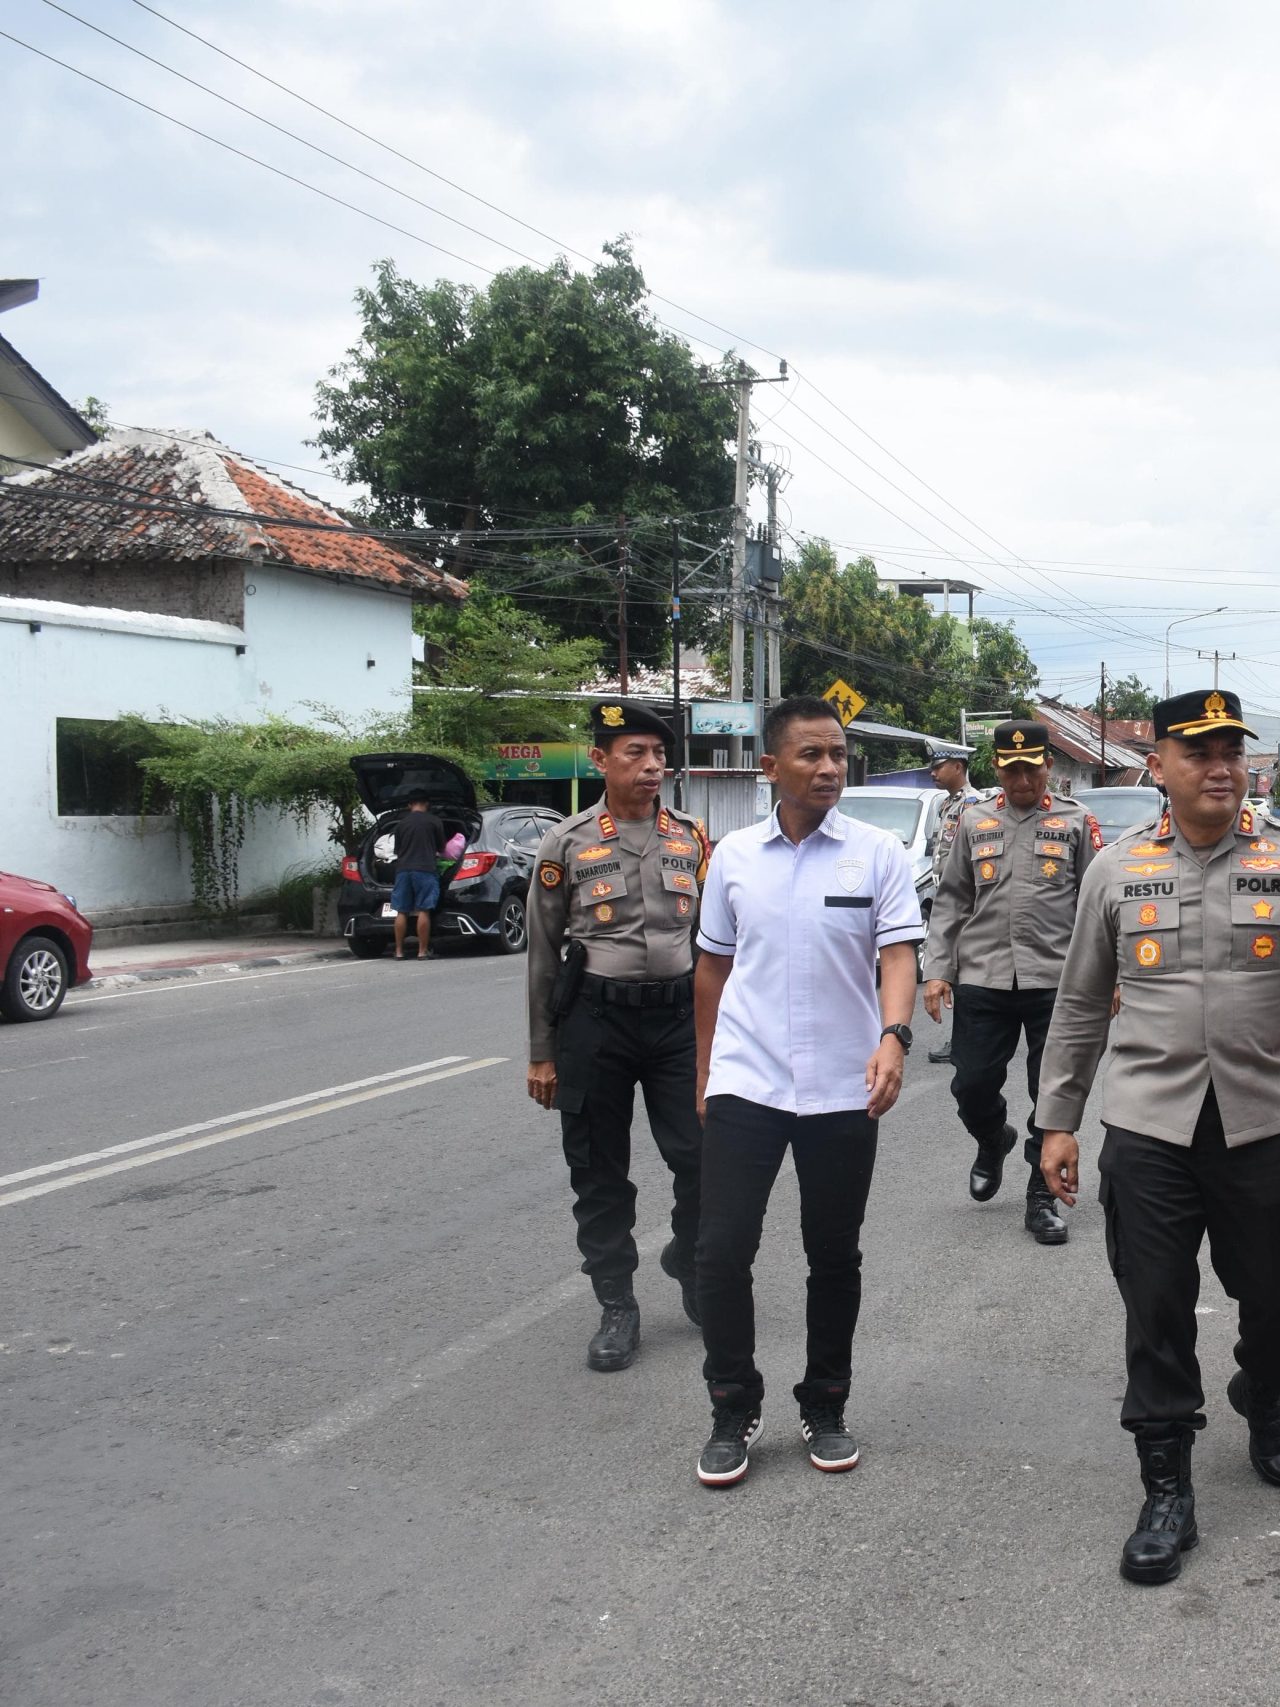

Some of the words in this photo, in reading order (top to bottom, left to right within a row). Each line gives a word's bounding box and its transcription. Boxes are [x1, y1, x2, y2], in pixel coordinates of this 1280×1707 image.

[497, 745, 542, 759] MEGA
[1035, 831, 1071, 842] POLRI
[575, 861, 621, 881] BAHARUDDIN
[661, 857, 696, 873] POLRI
[1123, 881, 1174, 898] RESTU
